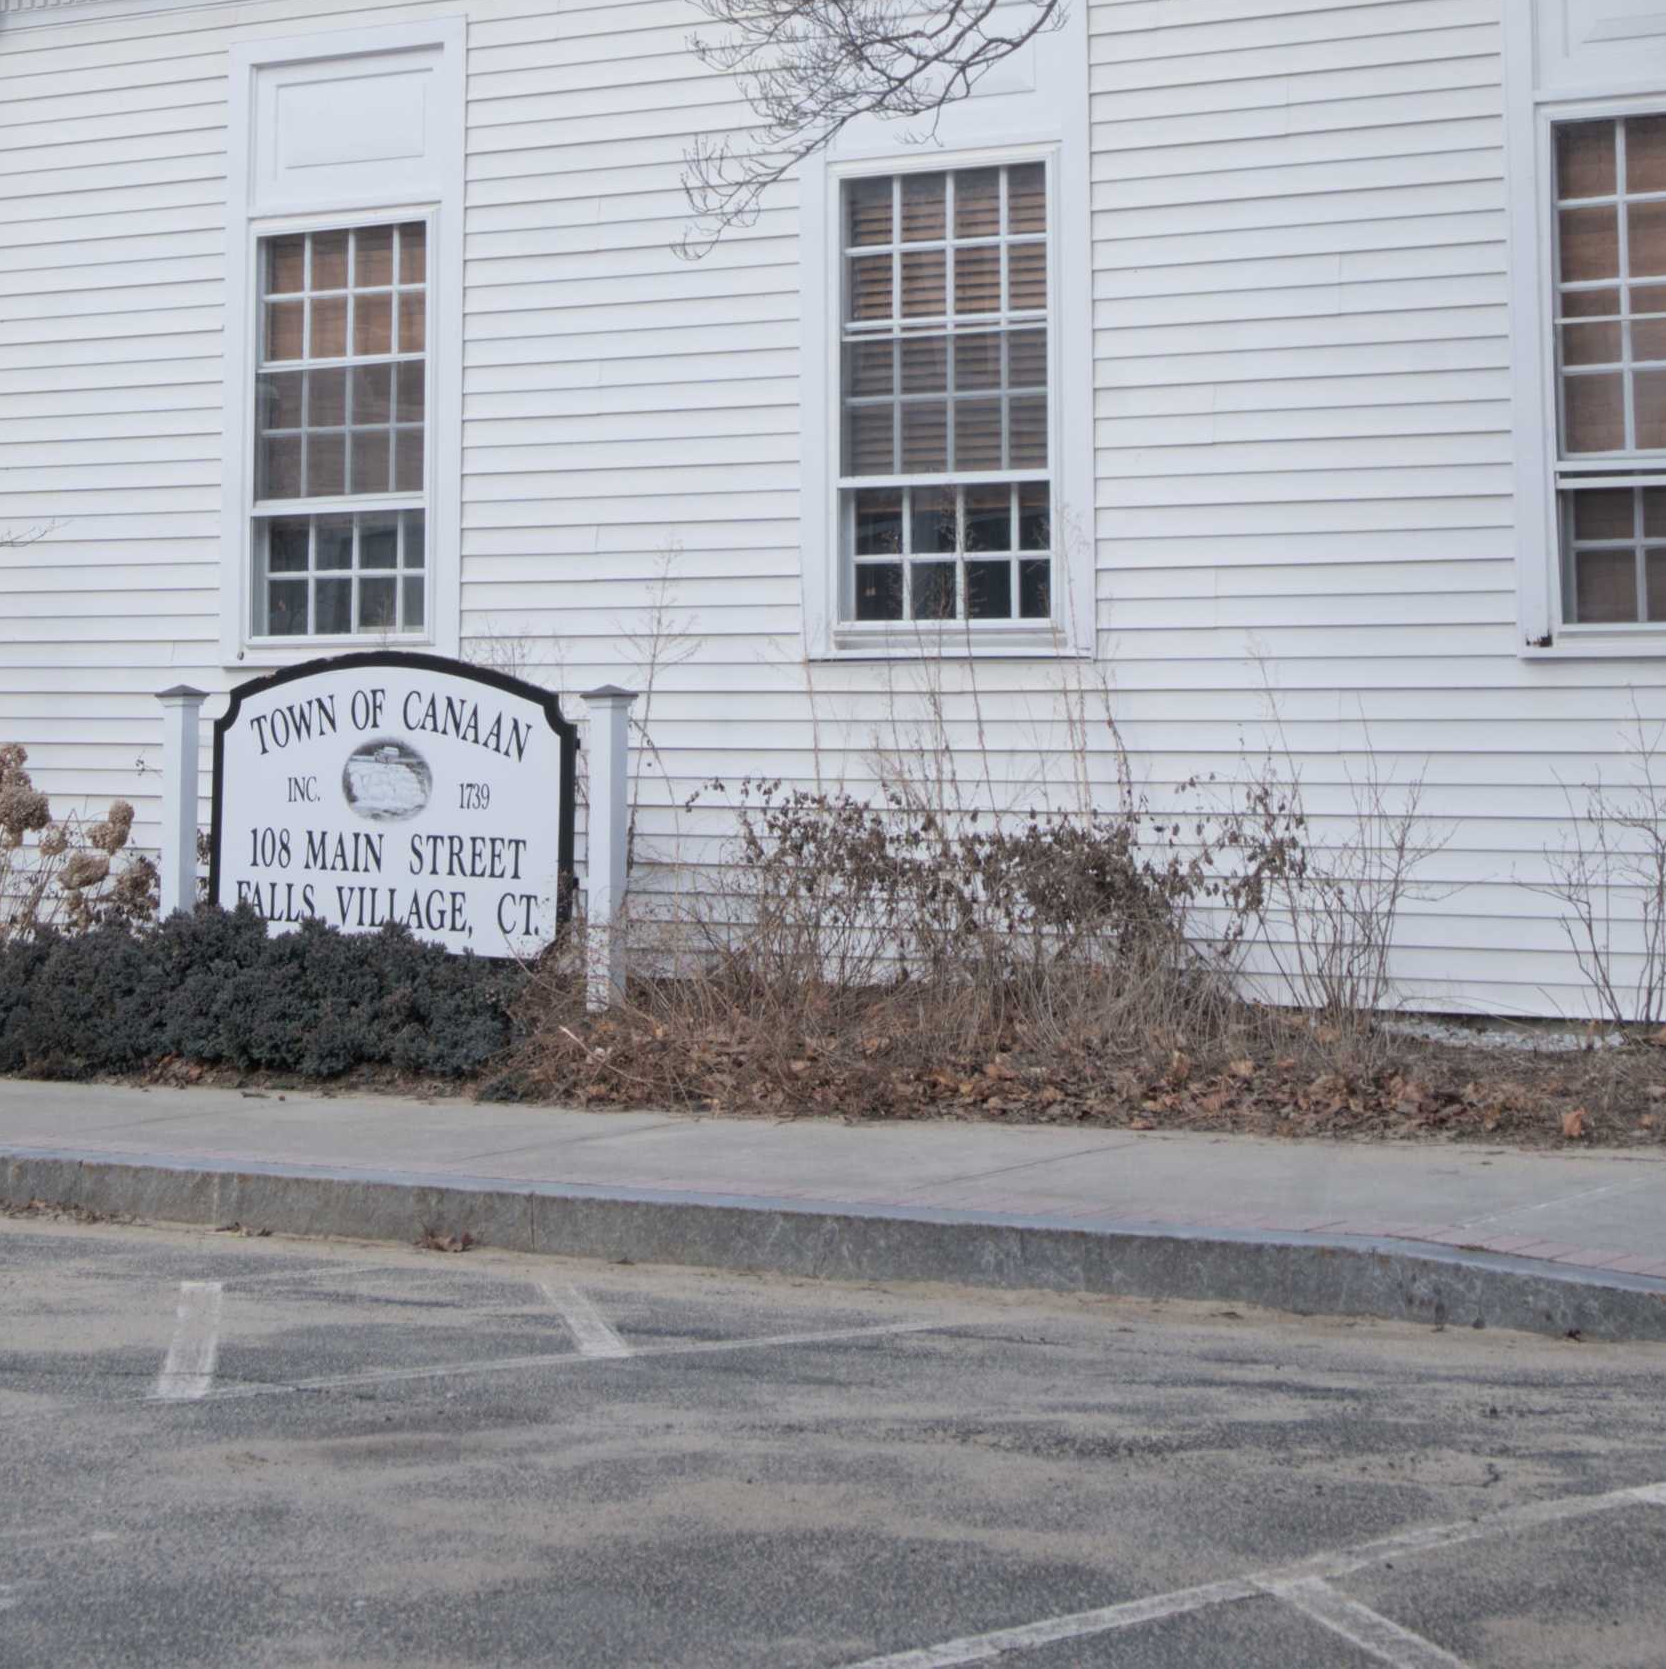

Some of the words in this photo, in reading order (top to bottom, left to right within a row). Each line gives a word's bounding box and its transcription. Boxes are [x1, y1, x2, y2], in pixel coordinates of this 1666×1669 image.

[250, 694, 337, 755] TOWN
[351, 689, 386, 731] OF
[403, 691, 532, 763] CANAAN
[287, 776, 321, 803] INC.
[459, 783, 491, 810] 1739
[250, 827, 291, 869] 108
[304, 830, 384, 873] MAIN
[409, 834, 527, 880] STREET
[336, 886, 474, 938] VILLAGE,
